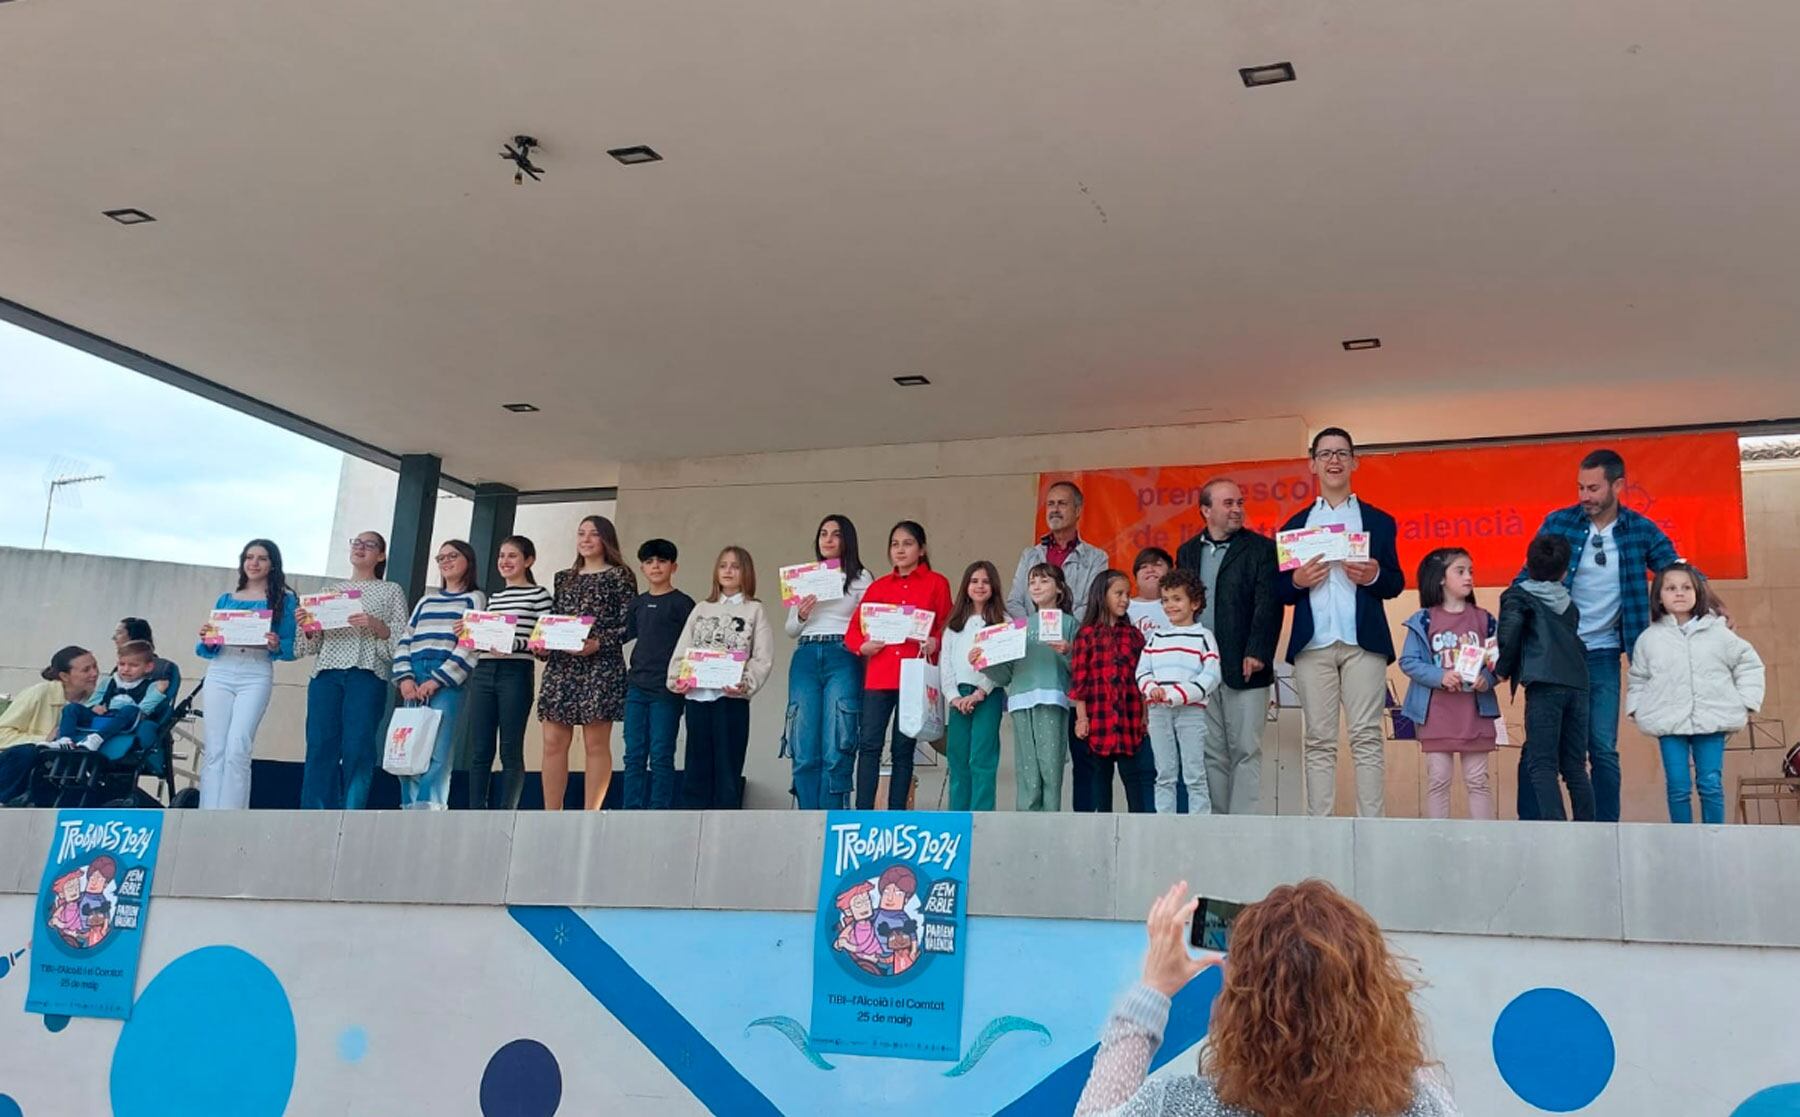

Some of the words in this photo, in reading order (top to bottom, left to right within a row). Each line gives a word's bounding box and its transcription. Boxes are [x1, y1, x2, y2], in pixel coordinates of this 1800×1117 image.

[57, 820, 124, 864] TROBADES
[119, 826, 154, 859] 2024
[831, 823, 918, 876] TROBADES
[917, 831, 961, 870] 2024
[931, 882, 955, 897] FEM
[895, 998, 905, 1009] el
[906, 999, 945, 1011] Comtat
[857, 1011, 870, 1022] 25
[872, 1012, 885, 1023] de
[887, 1013, 913, 1028] maig
